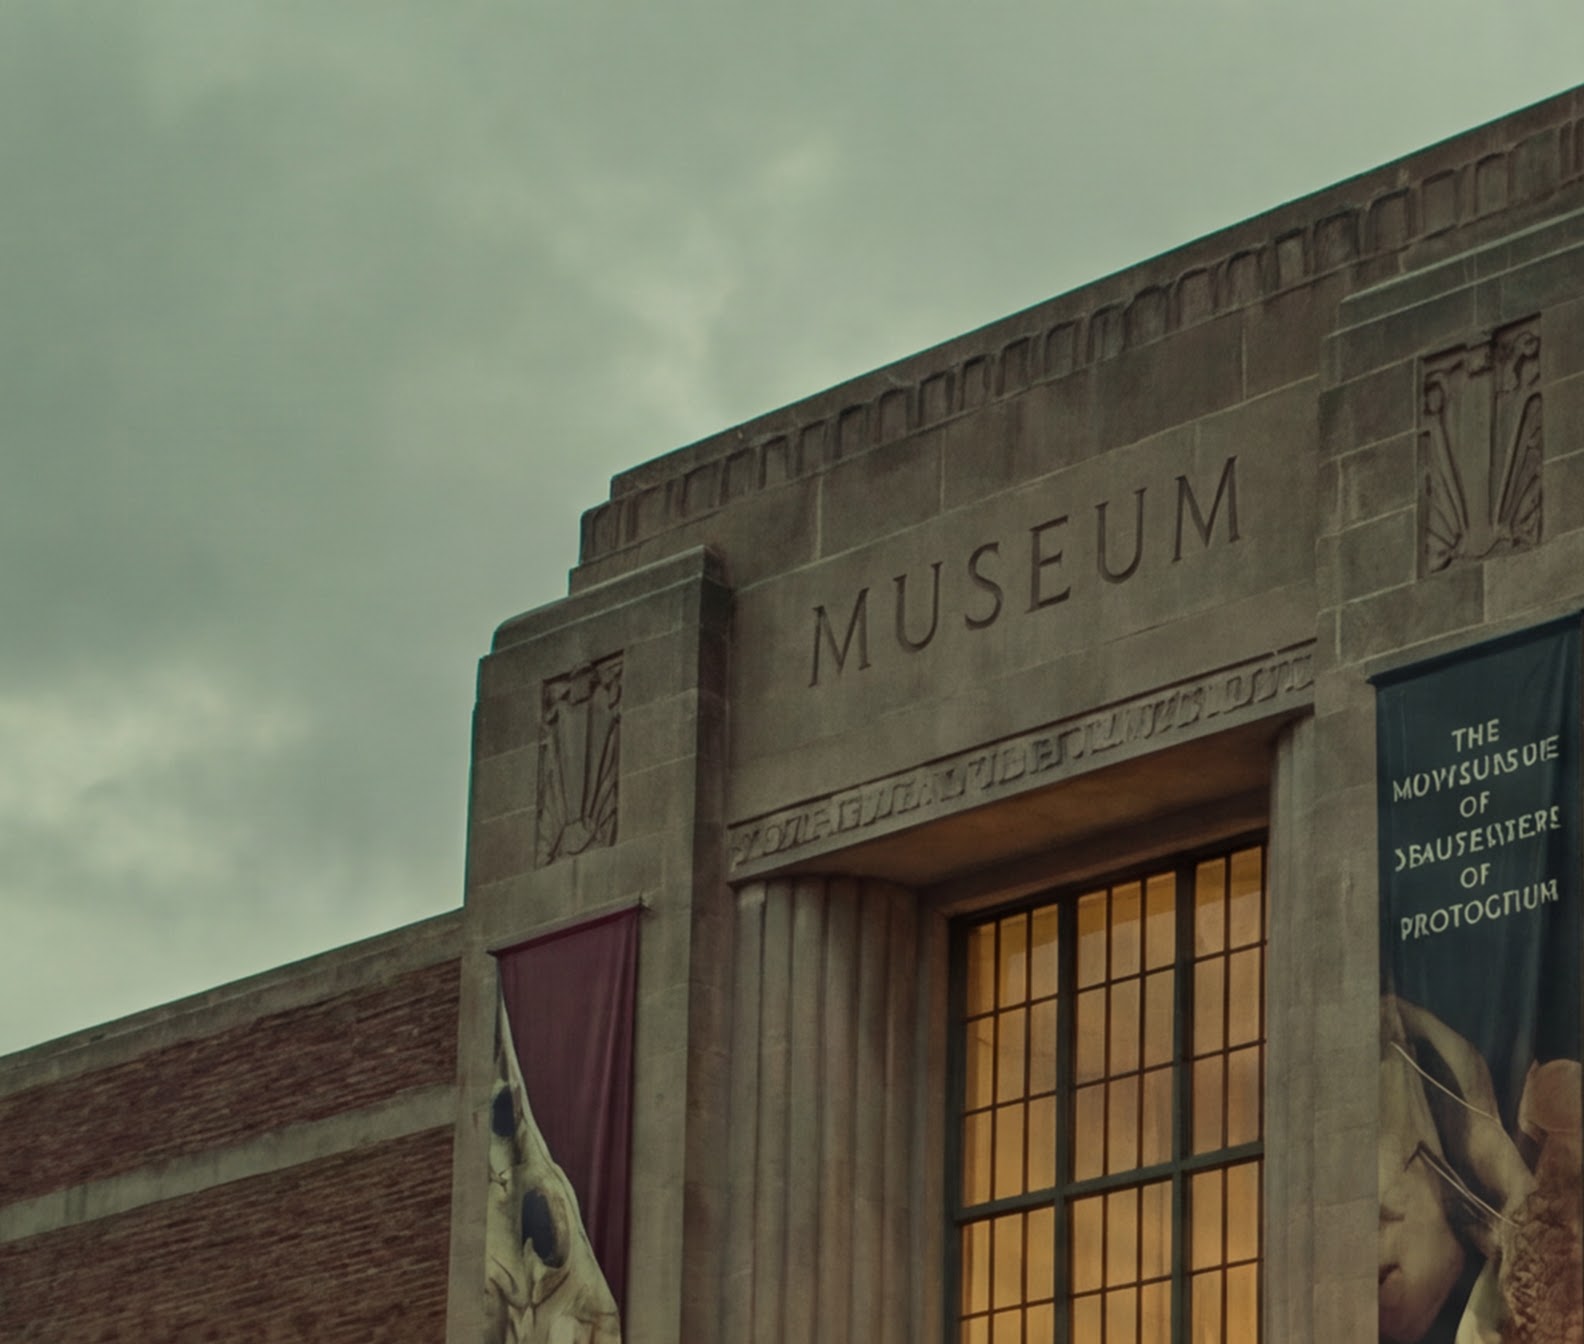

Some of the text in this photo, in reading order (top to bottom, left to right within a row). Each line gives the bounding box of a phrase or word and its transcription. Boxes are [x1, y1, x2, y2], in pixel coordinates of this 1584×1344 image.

[807, 456, 1242, 689] MUSEUM
[1451, 718, 1500, 752] THE
[1459, 791, 1490, 818] OF
[1459, 863, 1491, 889] OF
